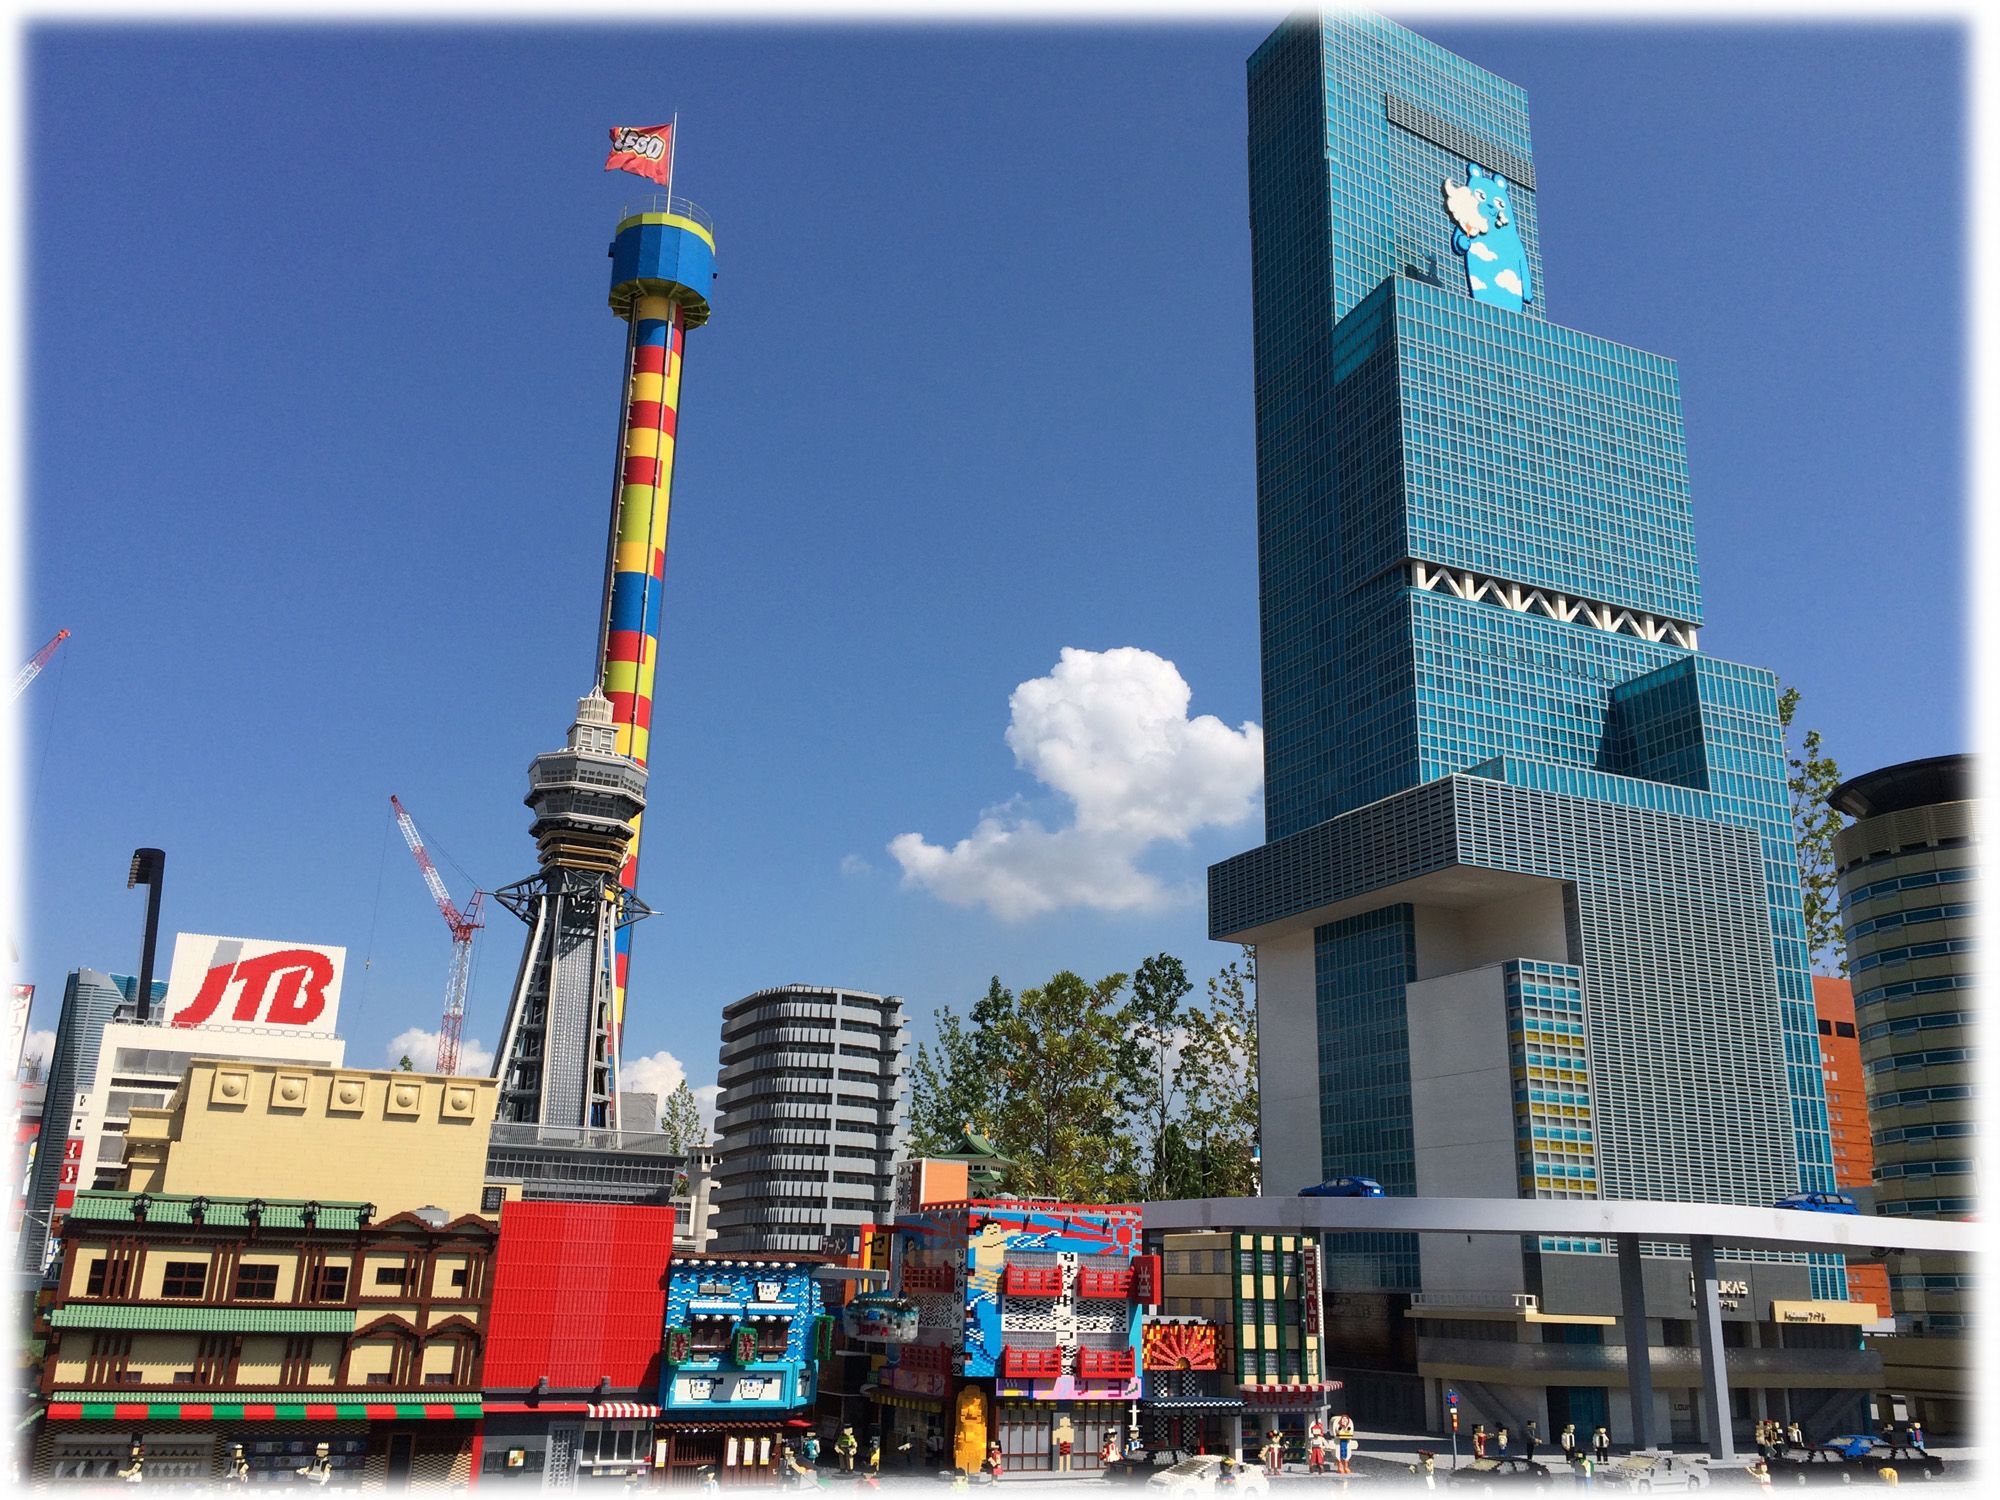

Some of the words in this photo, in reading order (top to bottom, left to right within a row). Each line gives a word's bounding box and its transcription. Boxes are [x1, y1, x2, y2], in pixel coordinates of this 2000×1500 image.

[171, 941, 334, 1029] JTB
[822, 1236, 848, 1255] ラーメン
